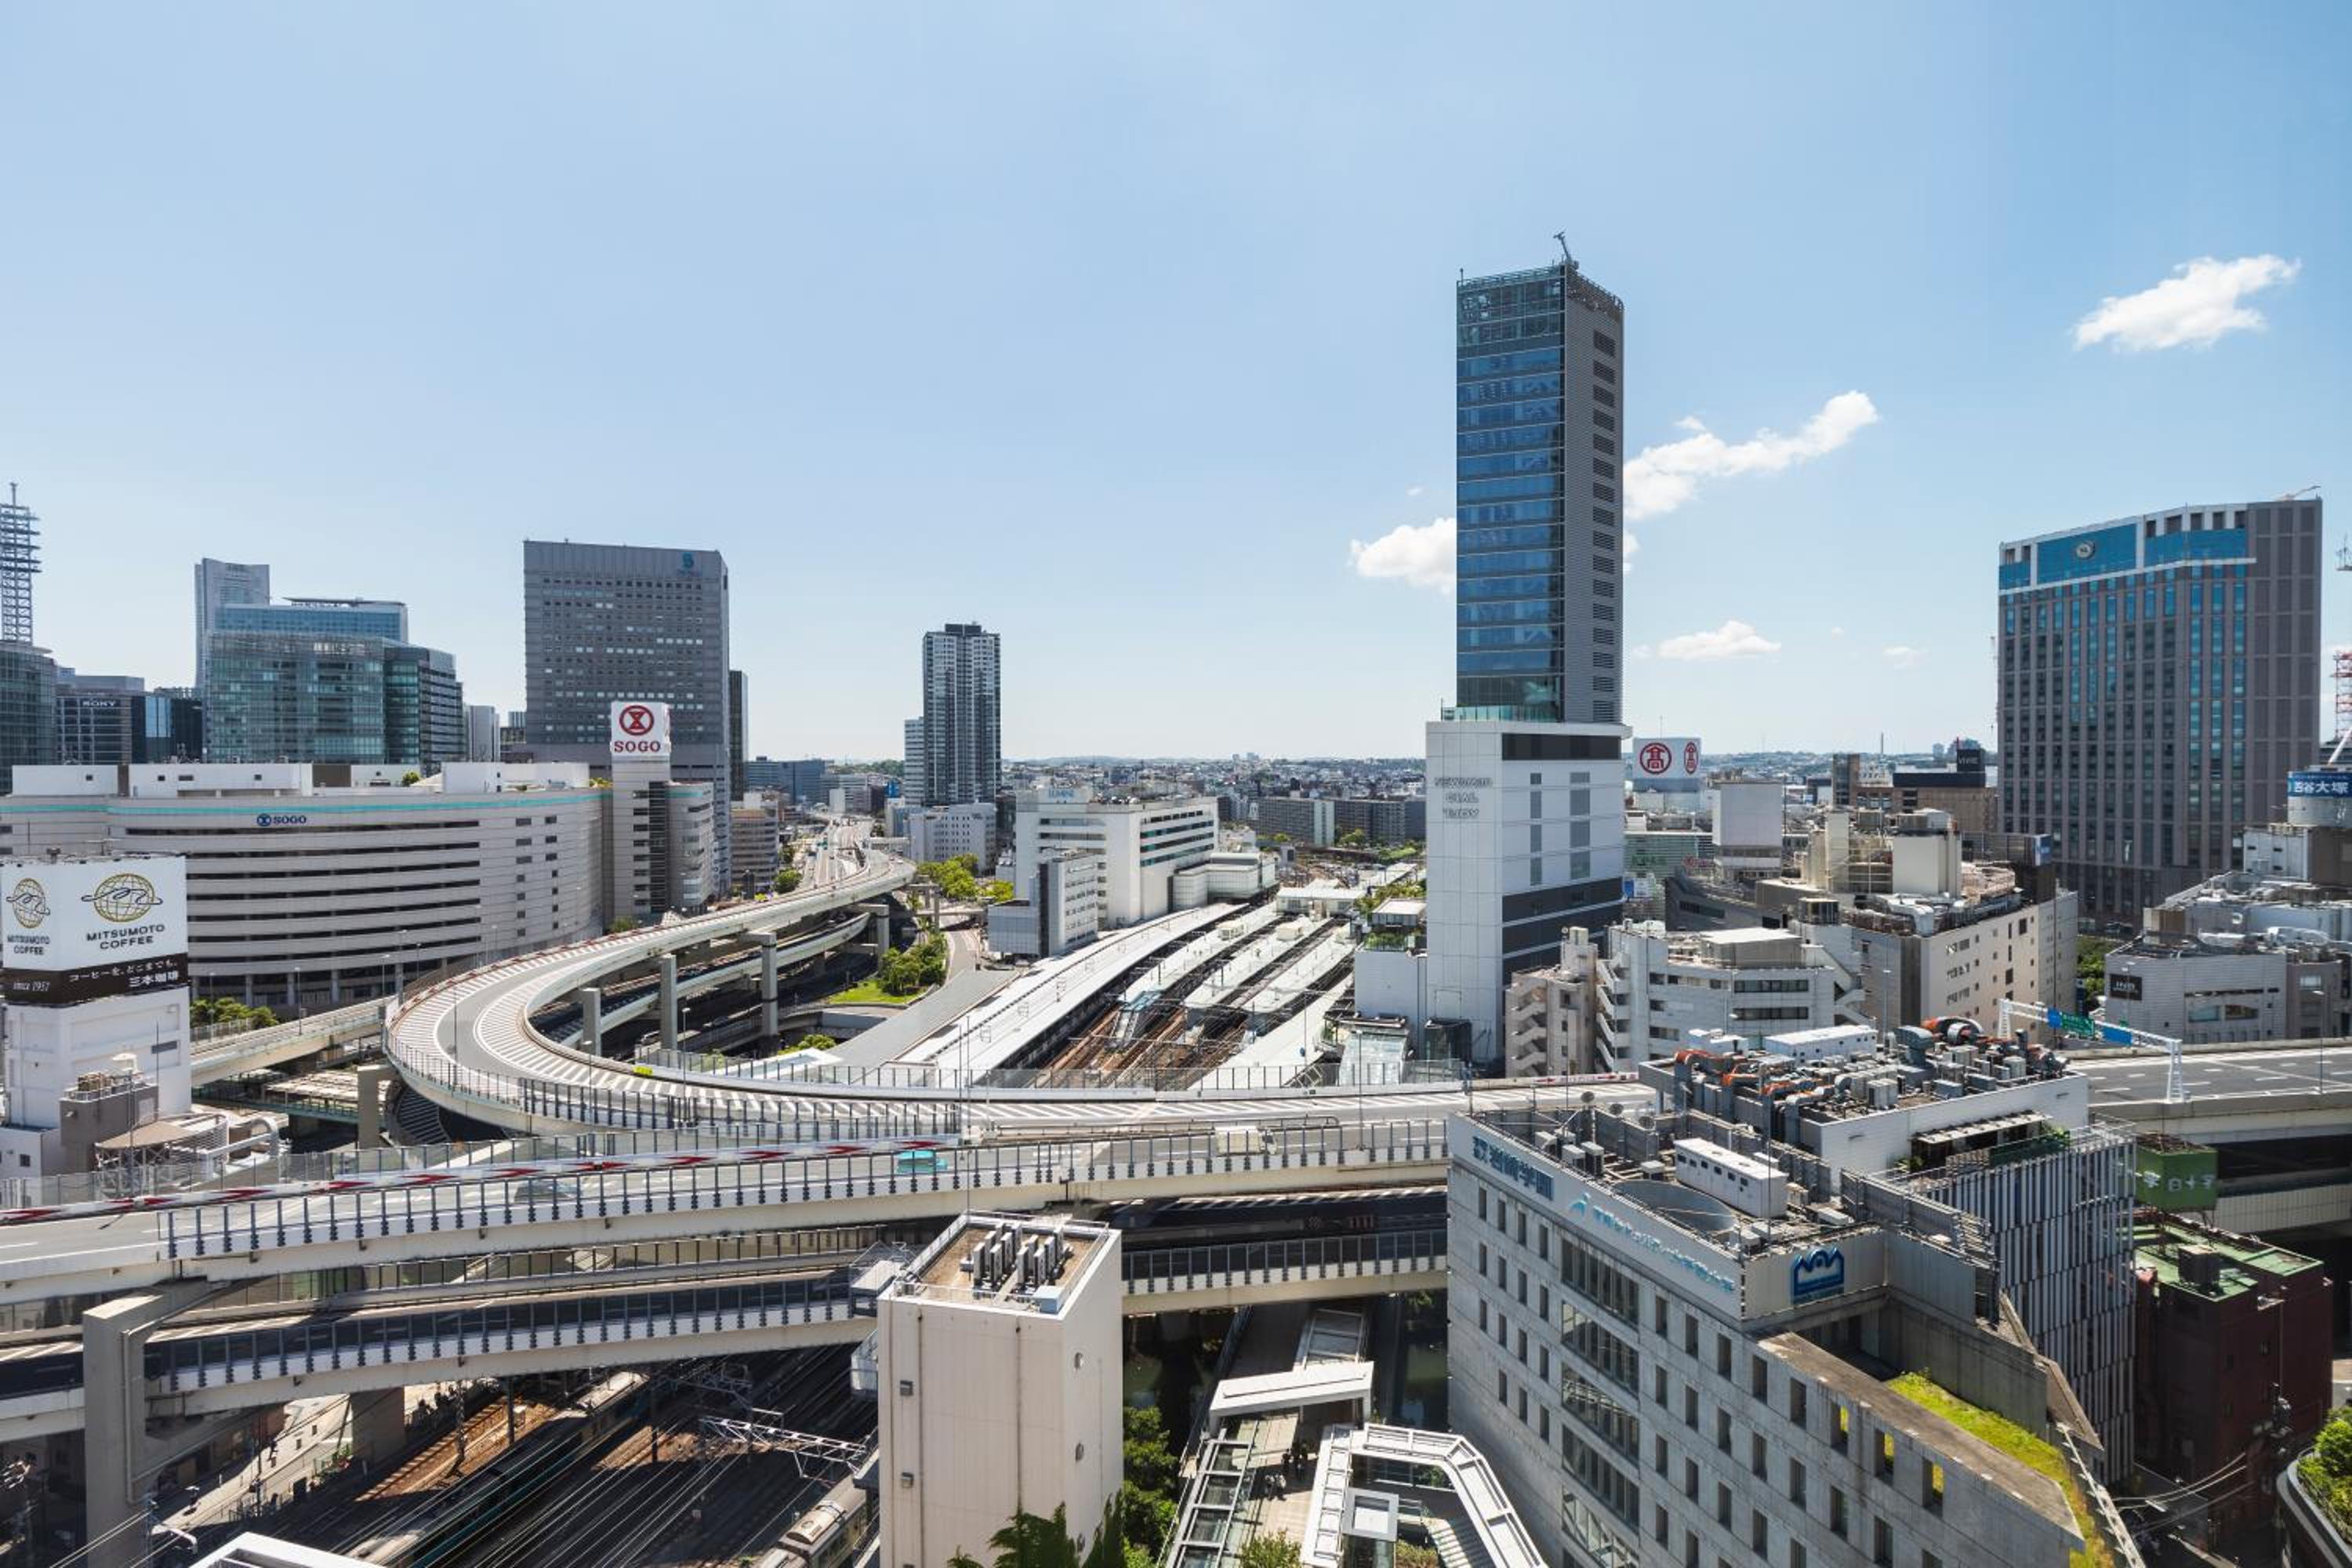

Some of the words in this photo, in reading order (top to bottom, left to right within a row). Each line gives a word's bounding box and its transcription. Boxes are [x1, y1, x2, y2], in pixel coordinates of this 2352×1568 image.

[614, 740, 661, 753] SOGO
[273, 815, 307, 824] SOGO
[86, 924, 165, 942] MITSUMOTO
[7, 934, 51, 945] MITSUMOTO
[100, 935, 154, 950] COFFEE
[13, 945, 45, 956] COFFEE
